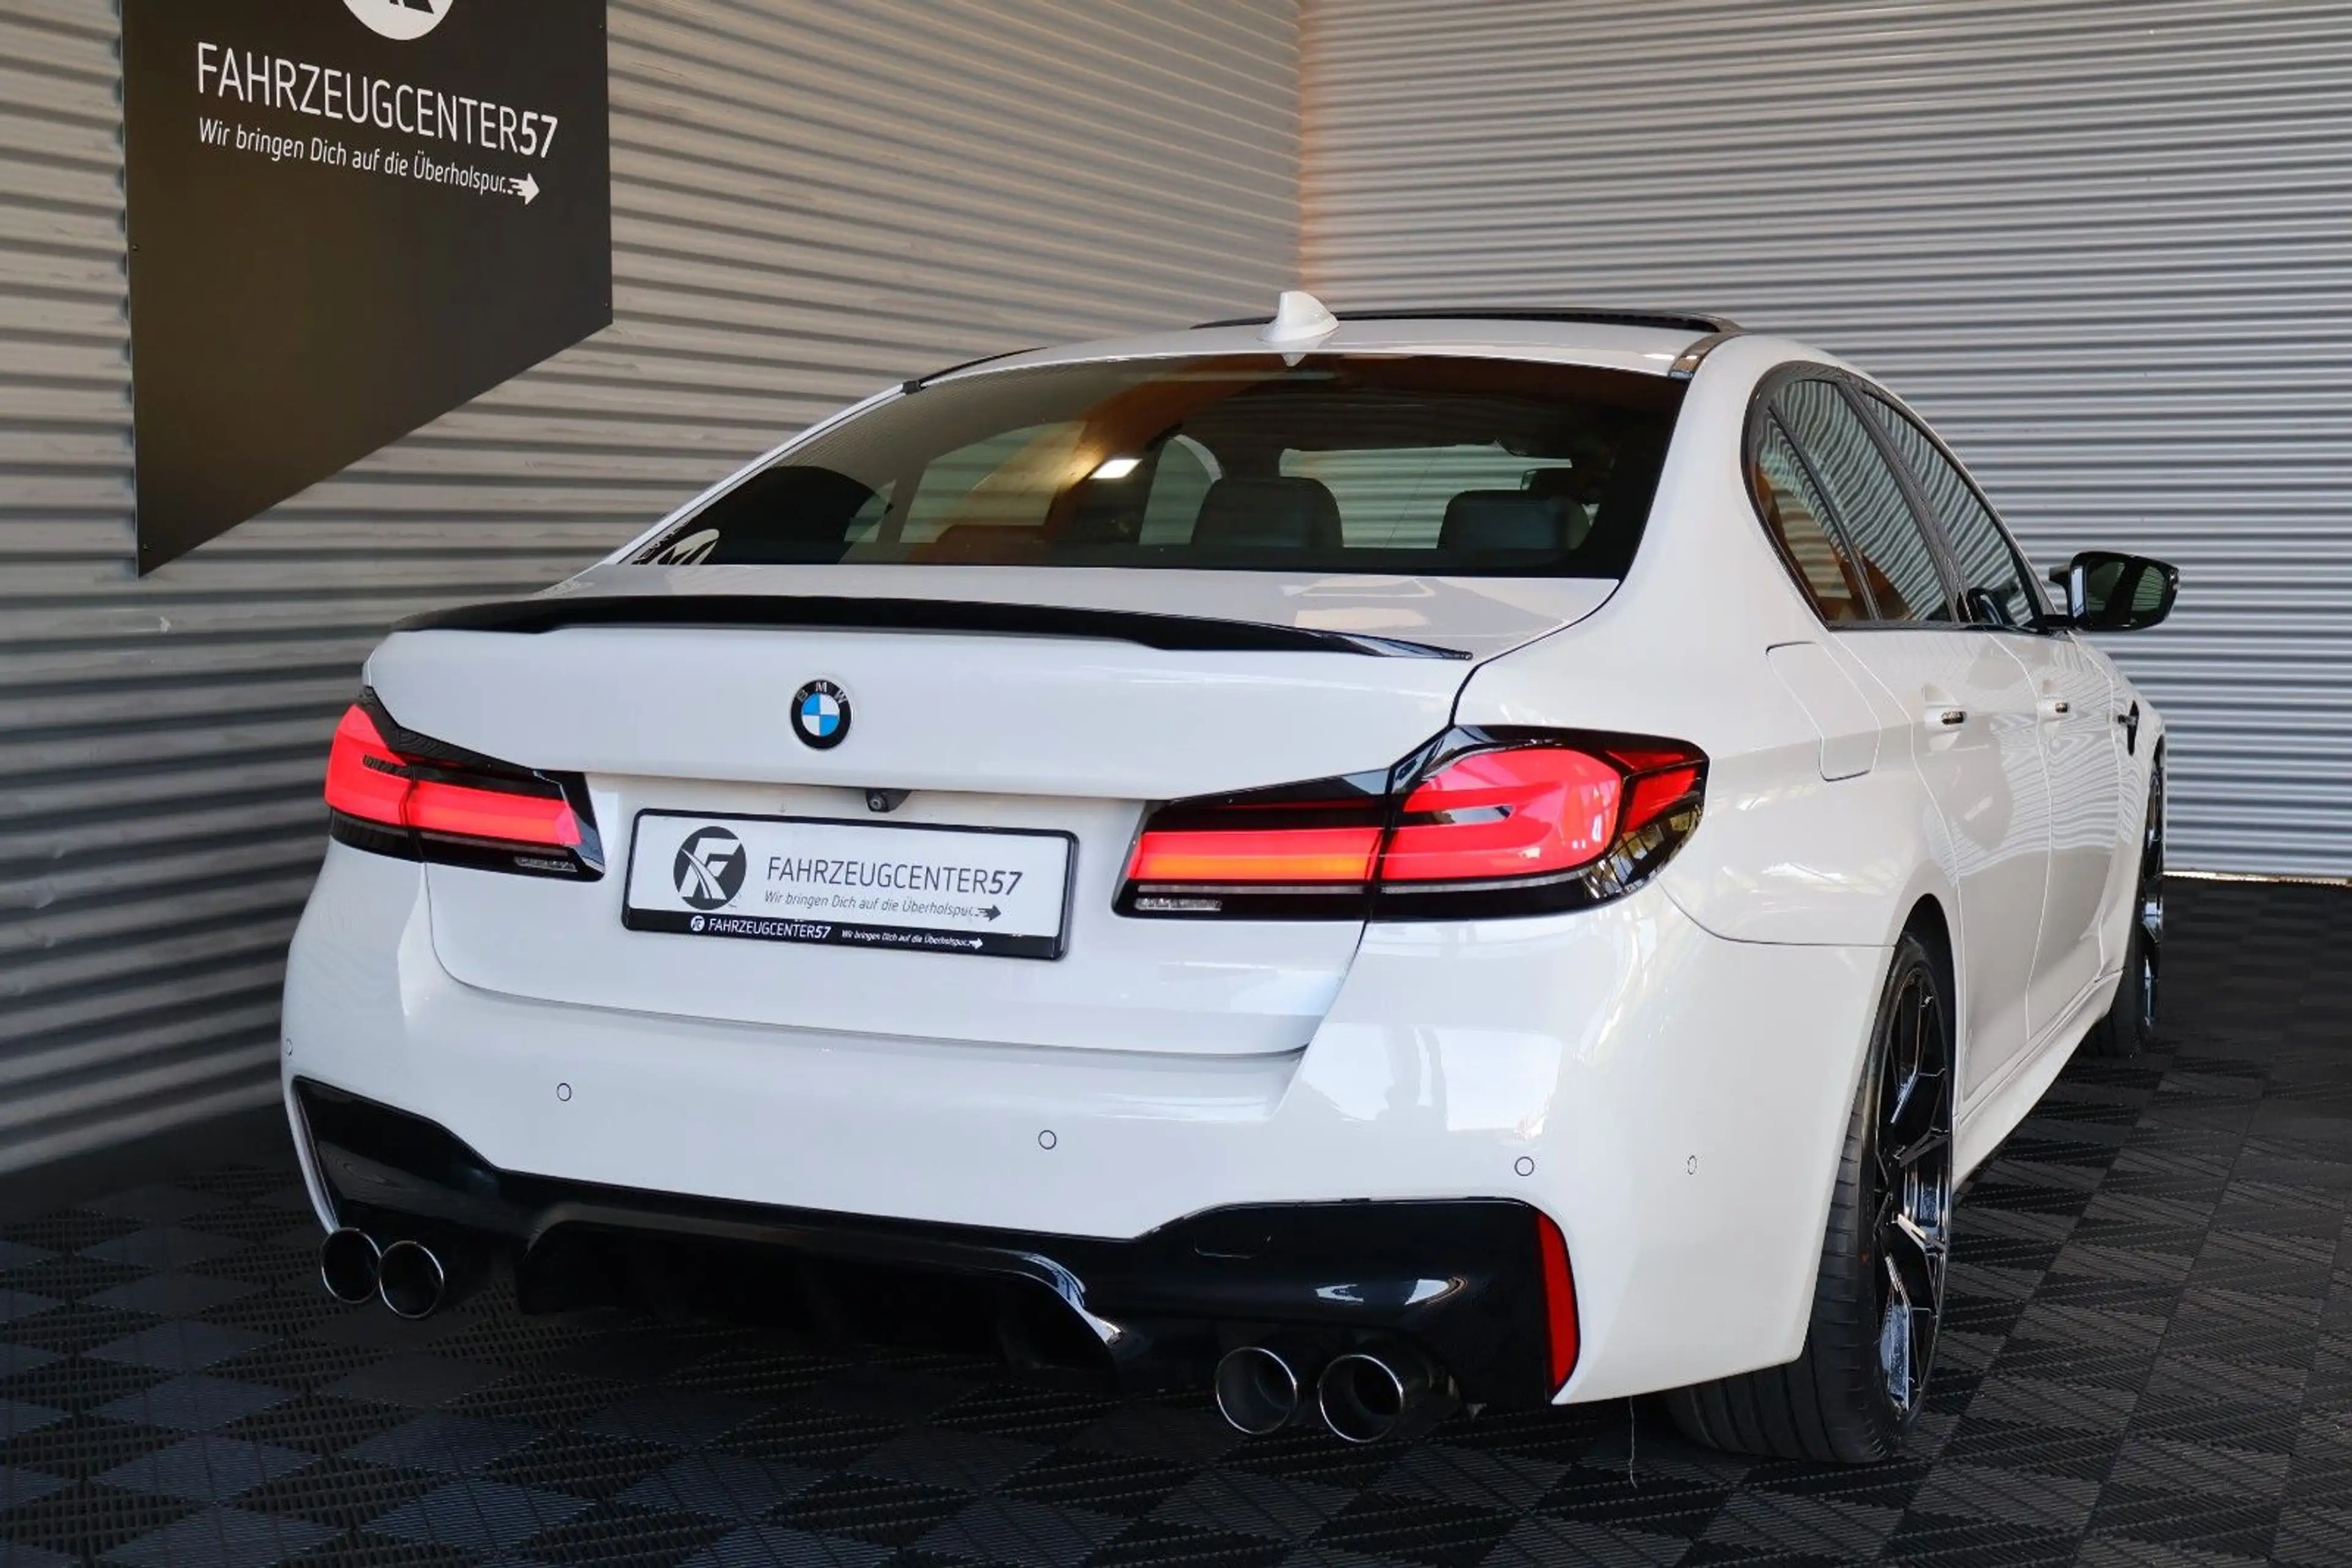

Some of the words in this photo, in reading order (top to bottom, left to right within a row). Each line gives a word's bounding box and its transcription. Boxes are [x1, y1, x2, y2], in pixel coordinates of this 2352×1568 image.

[198, 42, 558, 159] FAHRZEUGCENTER57
[199, 117, 230, 146] Wir
[236, 124, 304, 162] bringen
[310, 137, 347, 166] Dich
[352, 148, 380, 171] auf
[384, 151, 409, 176] die
[796, 681, 848, 704] BMW
[767, 856, 1023, 895] FAHRZEUGCENTER57
[765, 889, 783, 903] Wir
[786, 892, 829, 908] bringen
[831, 894, 856, 909] Dich
[859, 897, 880, 910] auf
[881, 898, 899, 911] die
[708, 918, 832, 939] FAHRZEUGCENTER57
[842, 929, 854, 939] Wir
[854, 930, 881, 941] bringen
[881, 932, 898, 942] Dich
[898, 934, 911, 943] auf
